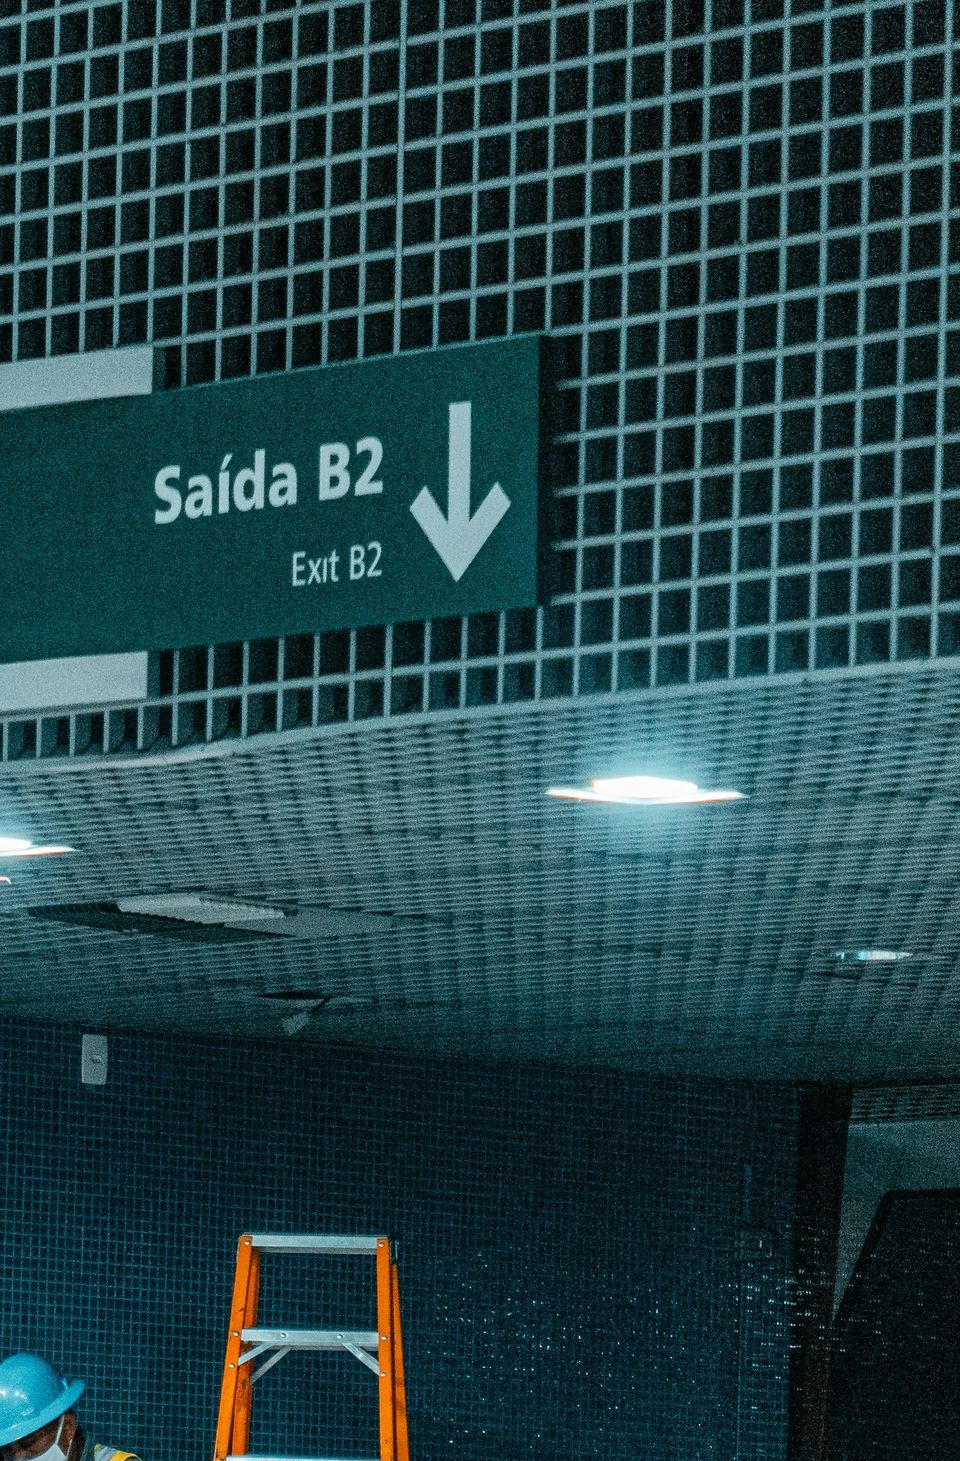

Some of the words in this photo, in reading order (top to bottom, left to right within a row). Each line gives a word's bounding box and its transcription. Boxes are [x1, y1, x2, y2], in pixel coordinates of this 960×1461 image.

[154, 449, 298, 524] Saída
[319, 436, 384, 500] B2
[292, 549, 340, 587] Exit
[349, 540, 383, 581] B2
